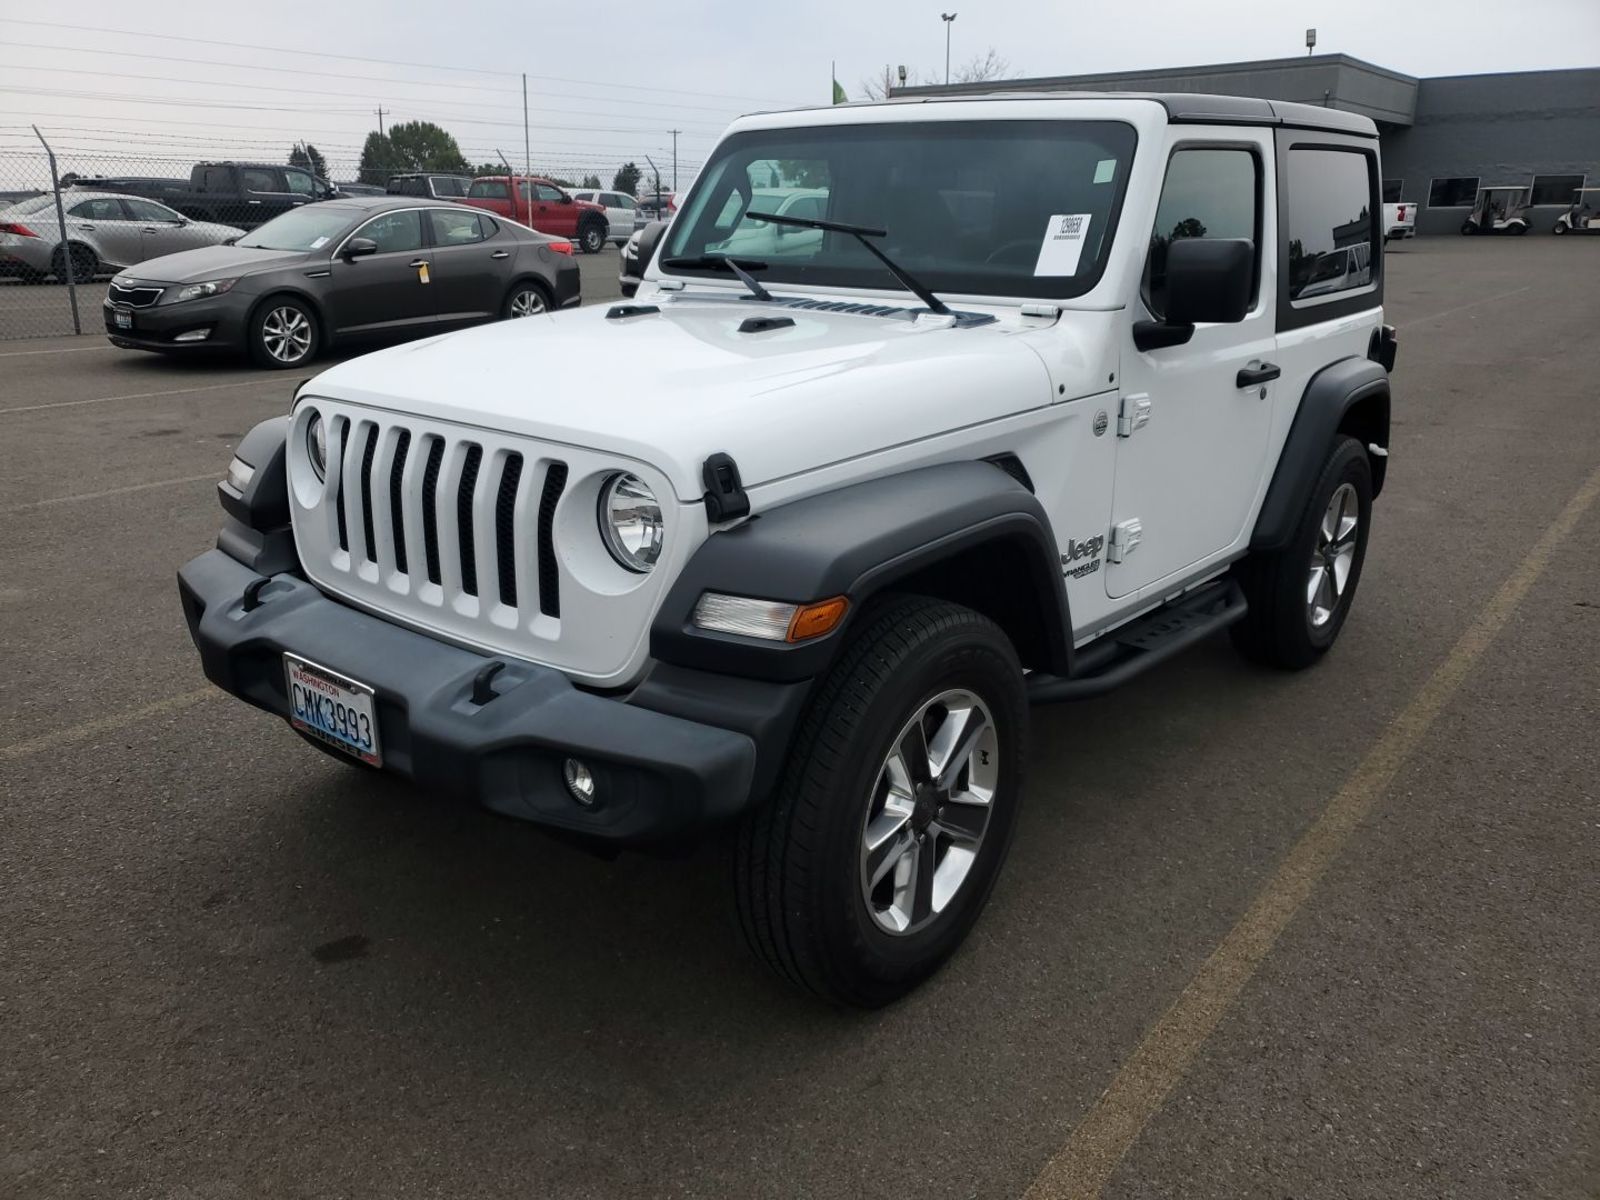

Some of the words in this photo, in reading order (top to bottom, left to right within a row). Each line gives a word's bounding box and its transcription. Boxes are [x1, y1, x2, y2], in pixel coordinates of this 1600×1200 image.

[1061, 534, 1104, 565] Jeep
[292, 670, 340, 698] WASHINGTON
[293, 683, 372, 749] CMK3993
